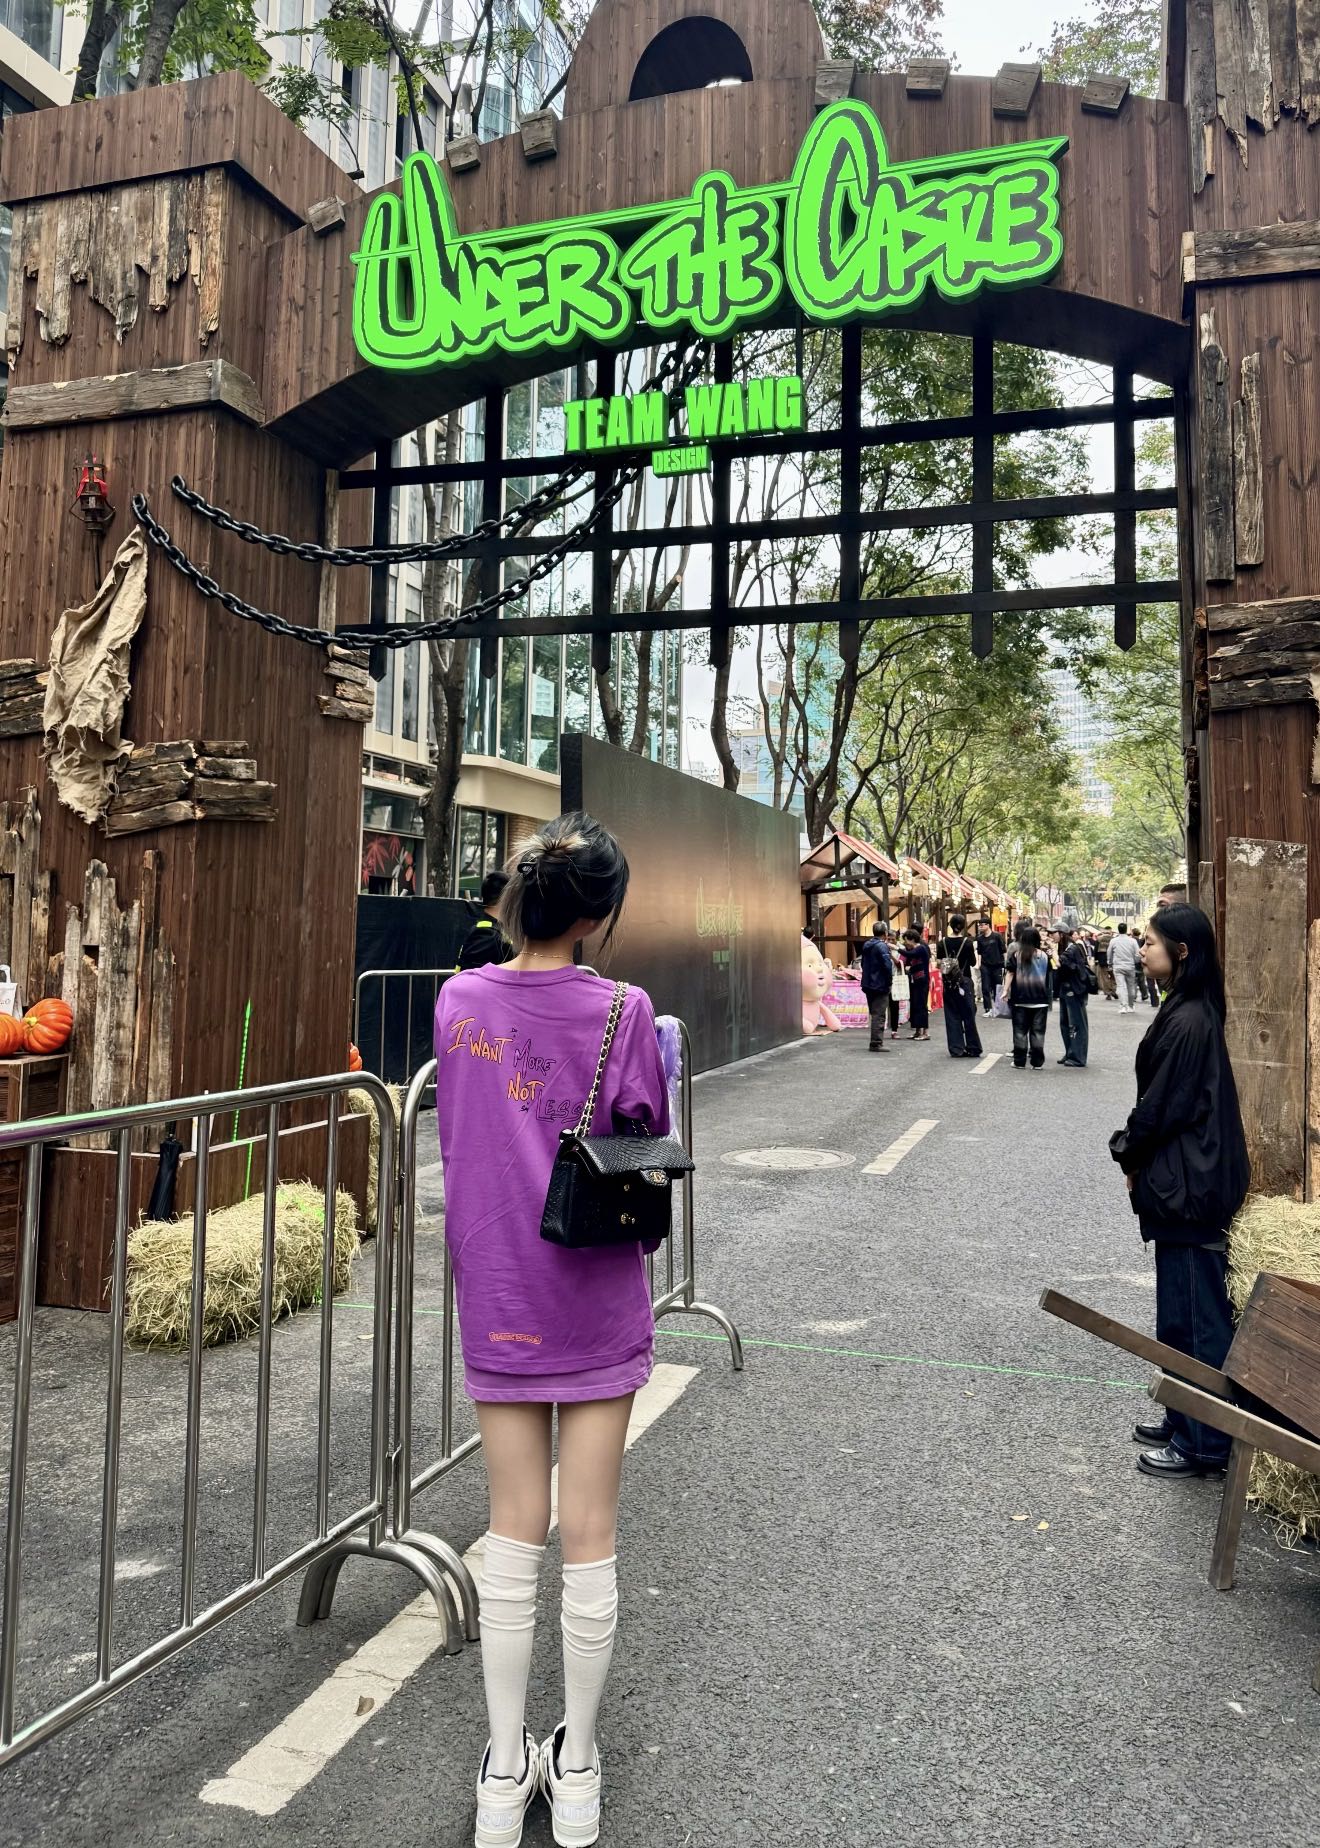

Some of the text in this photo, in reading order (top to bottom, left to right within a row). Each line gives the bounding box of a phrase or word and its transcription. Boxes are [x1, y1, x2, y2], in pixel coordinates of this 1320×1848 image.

[356, 101, 1061, 366] UNDER THE CASTLE
[564, 376, 802, 451] TEAM WANG
[653, 447, 707, 473] DESIGN
[447, 1017, 557, 1079] I WANT MORE
[507, 1071, 545, 1101] NOT
